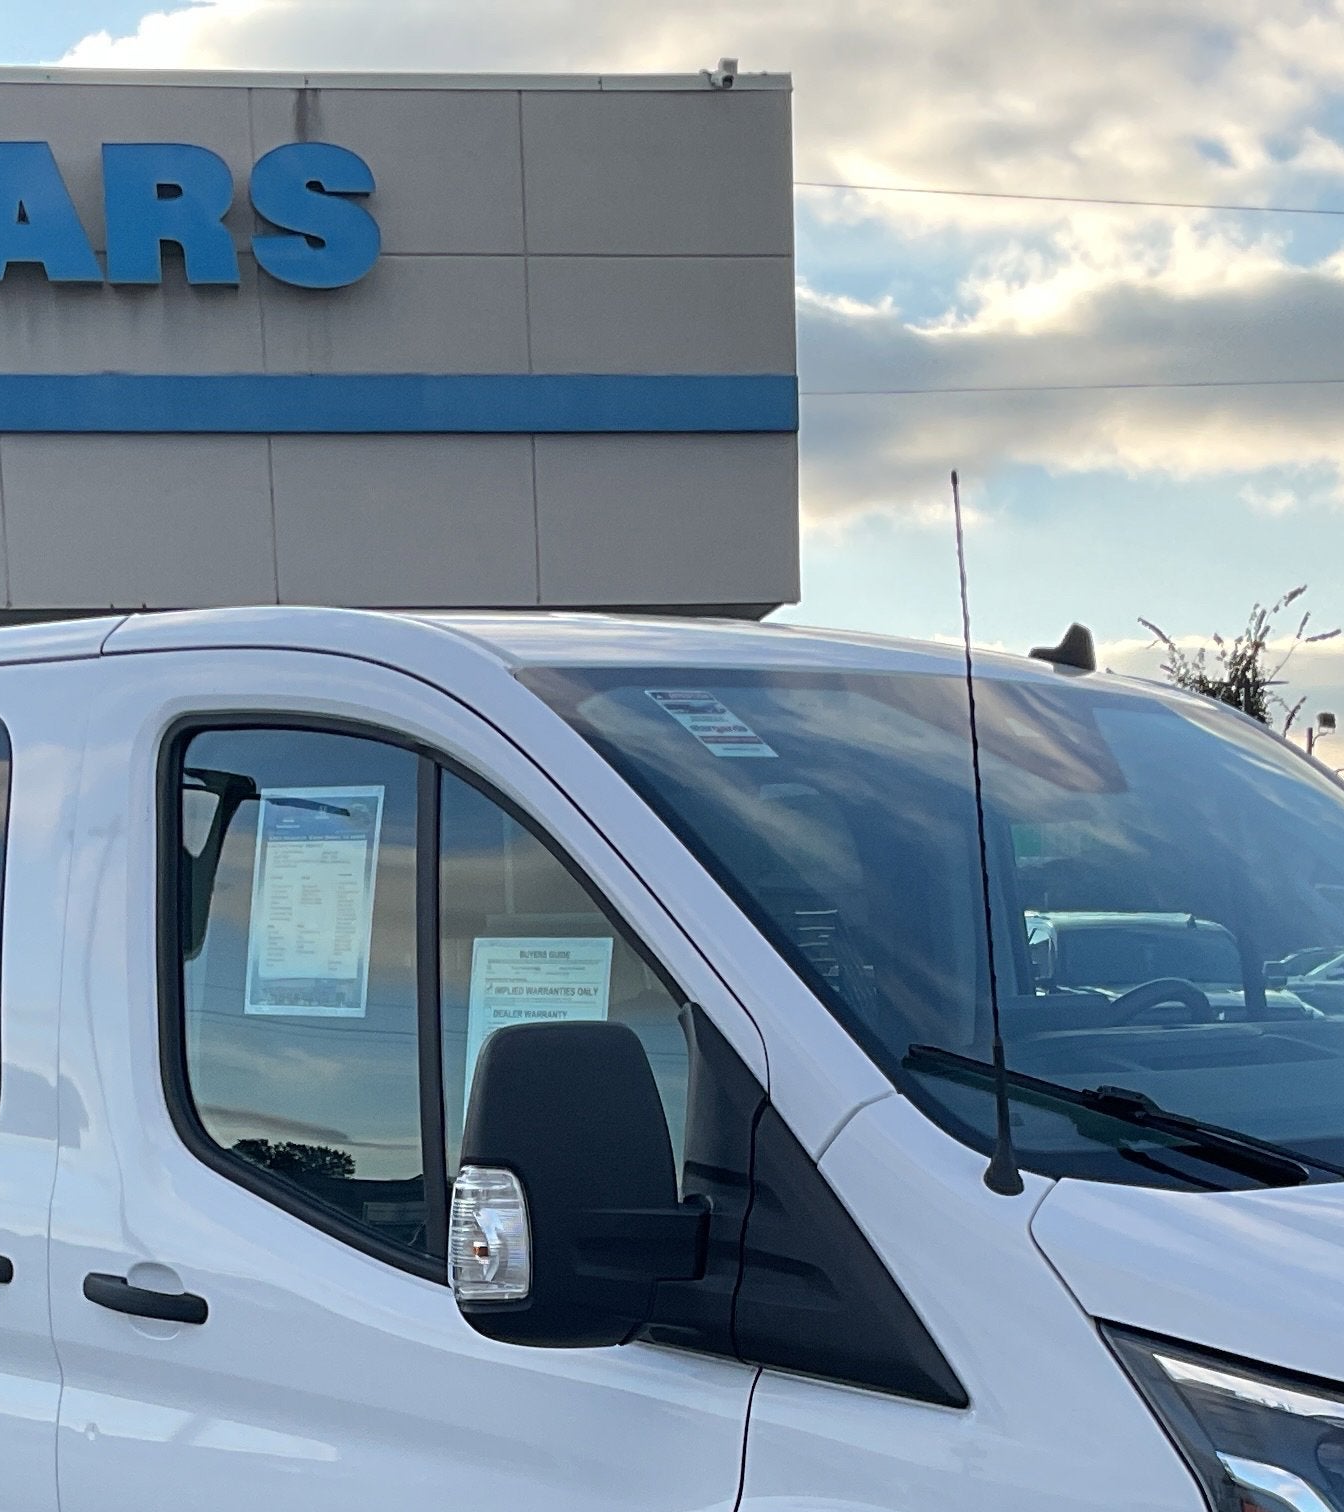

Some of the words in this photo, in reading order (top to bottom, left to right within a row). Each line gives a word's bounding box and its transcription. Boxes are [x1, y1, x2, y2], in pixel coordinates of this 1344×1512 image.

[520, 950, 547, 959] BUYERS
[549, 950, 571, 959] GUIDE
[494, 986, 525, 996] IMPLIED
[526, 986, 575, 997] WARRANTIES
[577, 986, 599, 997] ONLY
[493, 1009, 523, 1018] DEALER
[524, 1009, 568, 1019] WARRANTY
